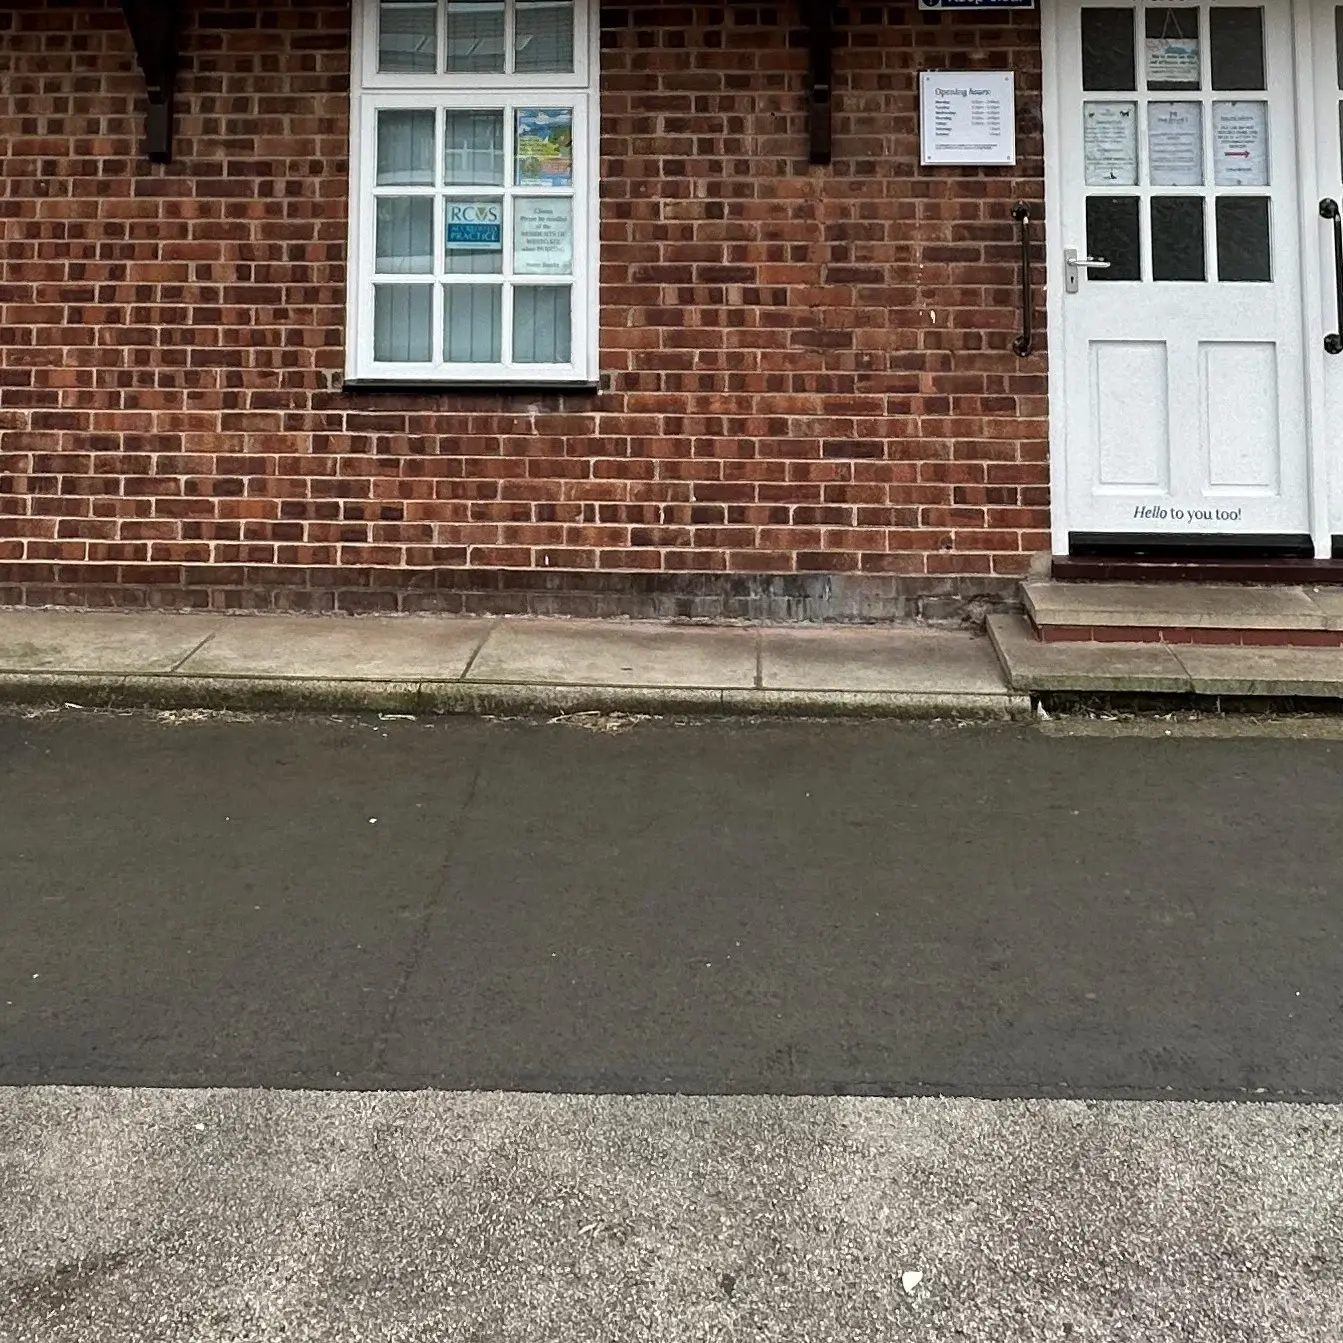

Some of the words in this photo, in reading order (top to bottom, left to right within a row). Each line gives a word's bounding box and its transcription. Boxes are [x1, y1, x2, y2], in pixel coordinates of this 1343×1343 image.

[934, 87, 968, 97] Opening
[451, 206, 498, 222] RCVS
[450, 232, 498, 241] PRACTICE
[1133, 505, 1168, 519] Hello
[1170, 508, 1184, 519] to
[1187, 510, 1213, 524] you
[1215, 508, 1242, 520] too!
